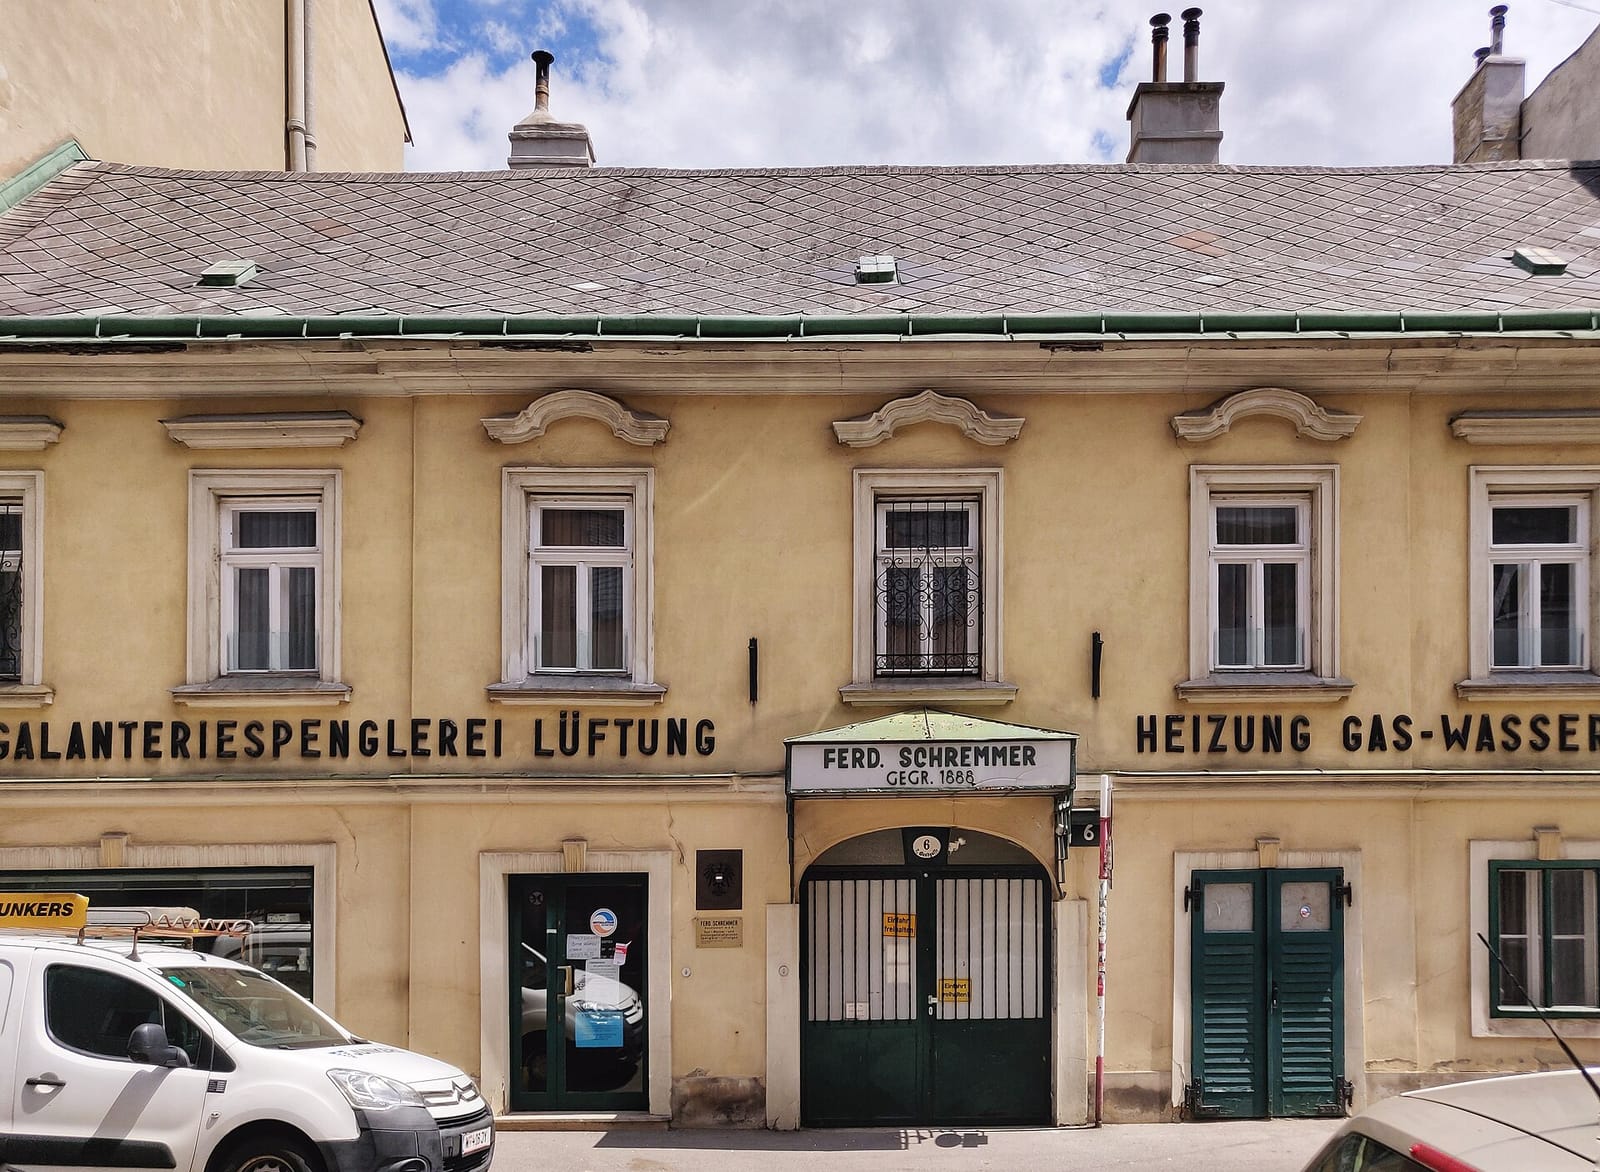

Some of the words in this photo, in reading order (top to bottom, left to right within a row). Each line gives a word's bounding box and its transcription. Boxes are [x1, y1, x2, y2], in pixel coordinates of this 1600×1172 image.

[535, 709, 716, 757] LÜFTUNG
[1136, 714, 1311, 754] HEIZUNG
[823, 747, 884, 769] FERD.
[899, 745, 1037, 768] SCHREMMER
[886, 770, 934, 786] GEGR.
[939, 769, 976, 786] 1888
[1083, 823, 1095, 841] 6
[923, 839, 930, 850] 6
[887, 916, 911, 924] Einahr
